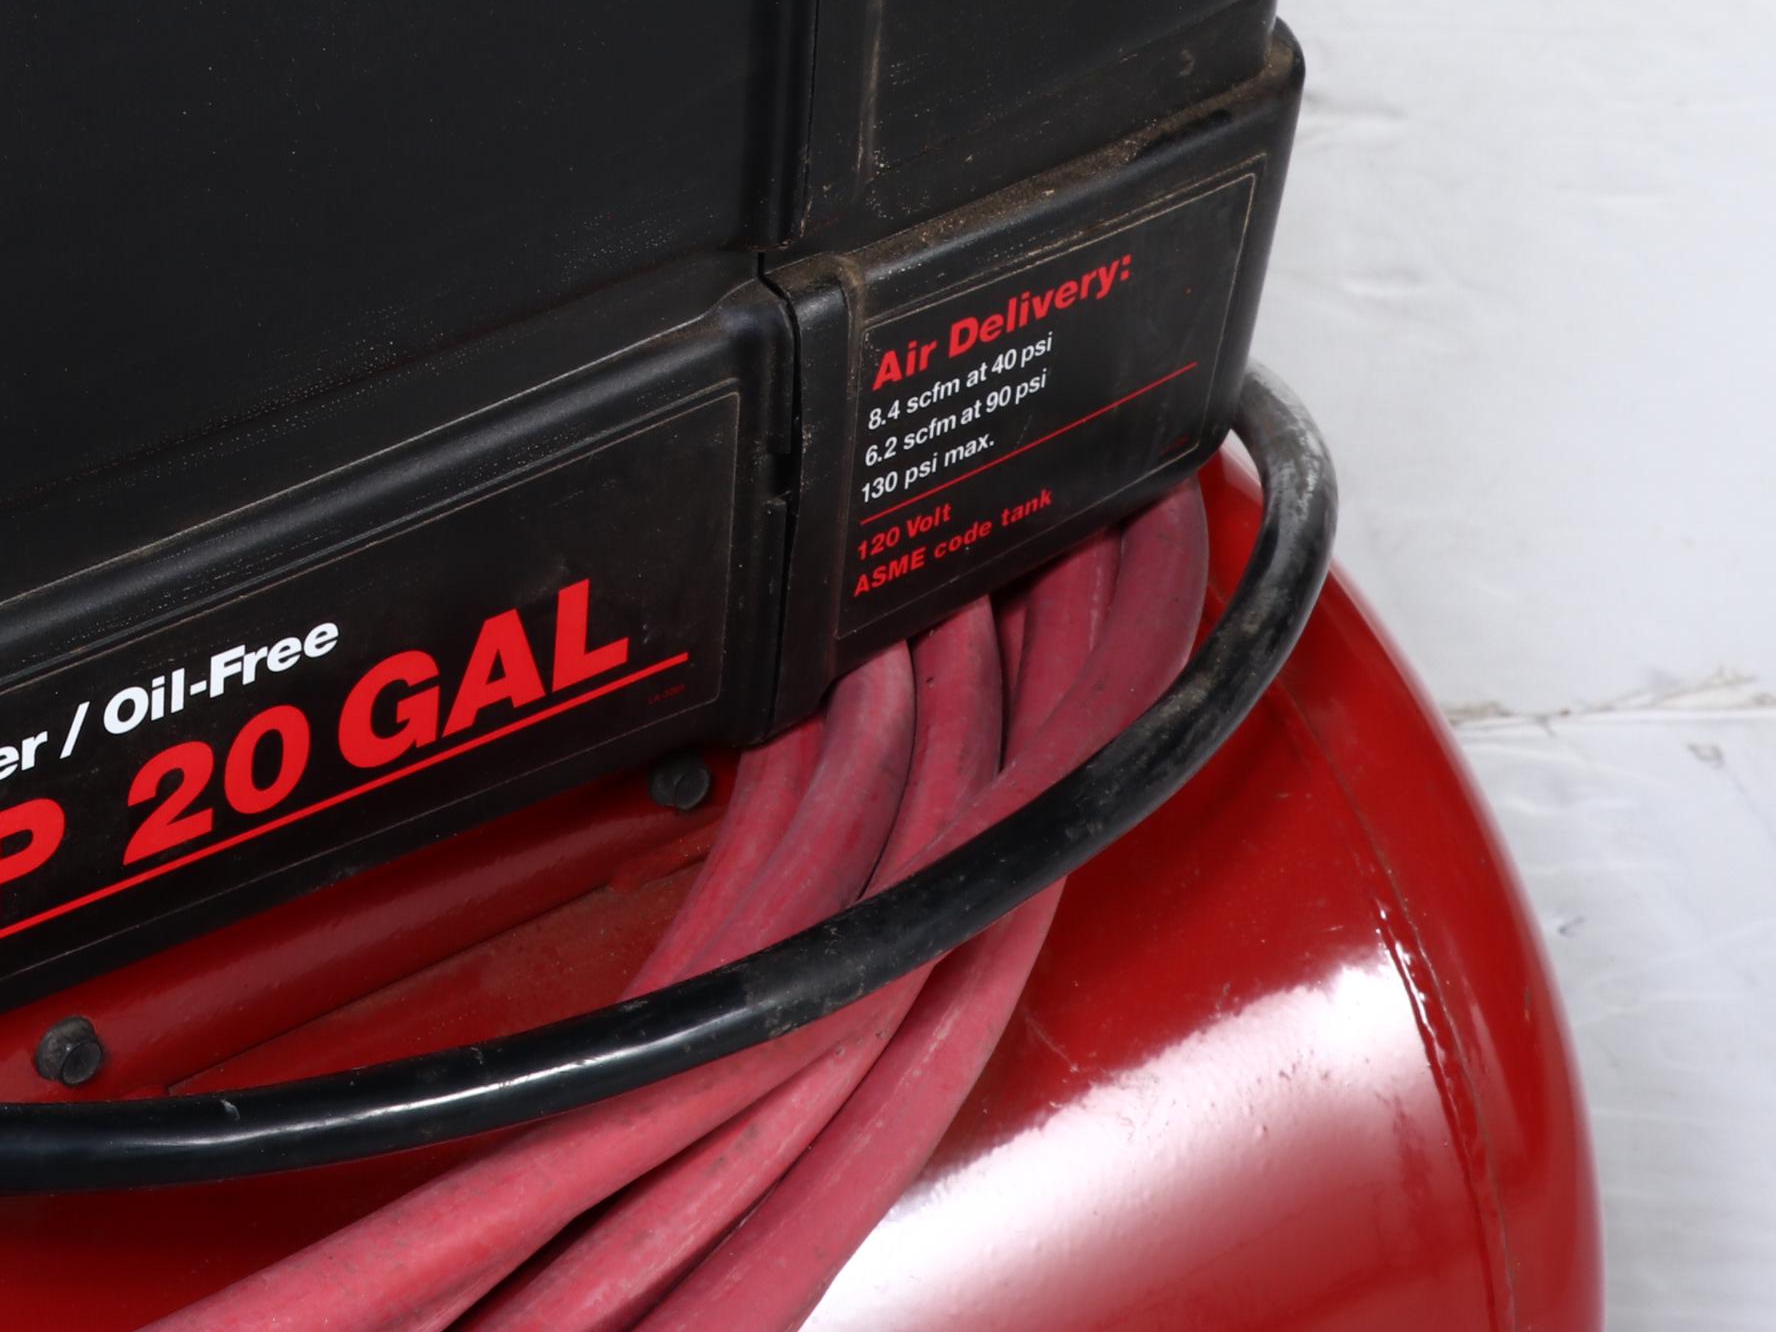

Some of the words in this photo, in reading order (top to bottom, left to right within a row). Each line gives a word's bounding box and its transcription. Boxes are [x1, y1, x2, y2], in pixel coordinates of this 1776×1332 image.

[873, 340, 937, 390] Air
[948, 254, 1132, 357] Delivery:
[865, 436, 897, 466] 6.2
[903, 415, 956, 450] scfm
[960, 399, 982, 425] at
[986, 385, 1012, 413] 90
[1015, 368, 1047, 405] psi
[868, 399, 900, 430] 8.4
[906, 378, 960, 413] scfm
[966, 362, 988, 388] at
[991, 348, 1017, 374] 40
[1020, 331, 1053, 368] psi
[862, 471, 898, 502] 130
[904, 452, 938, 489] psi
[944, 434, 994, 467] max.
[854, 547, 925, 596] ASME
[934, 521, 992, 558] code
[1001, 490, 1051, 526] tank
[858, 526, 900, 559] 120
[906, 504, 951, 538] Volt
[60, 701, 90, 759] /
[104, 623, 339, 734] Oil-Free
[123, 704, 310, 865] 20
[338, 580, 629, 768] GAL
